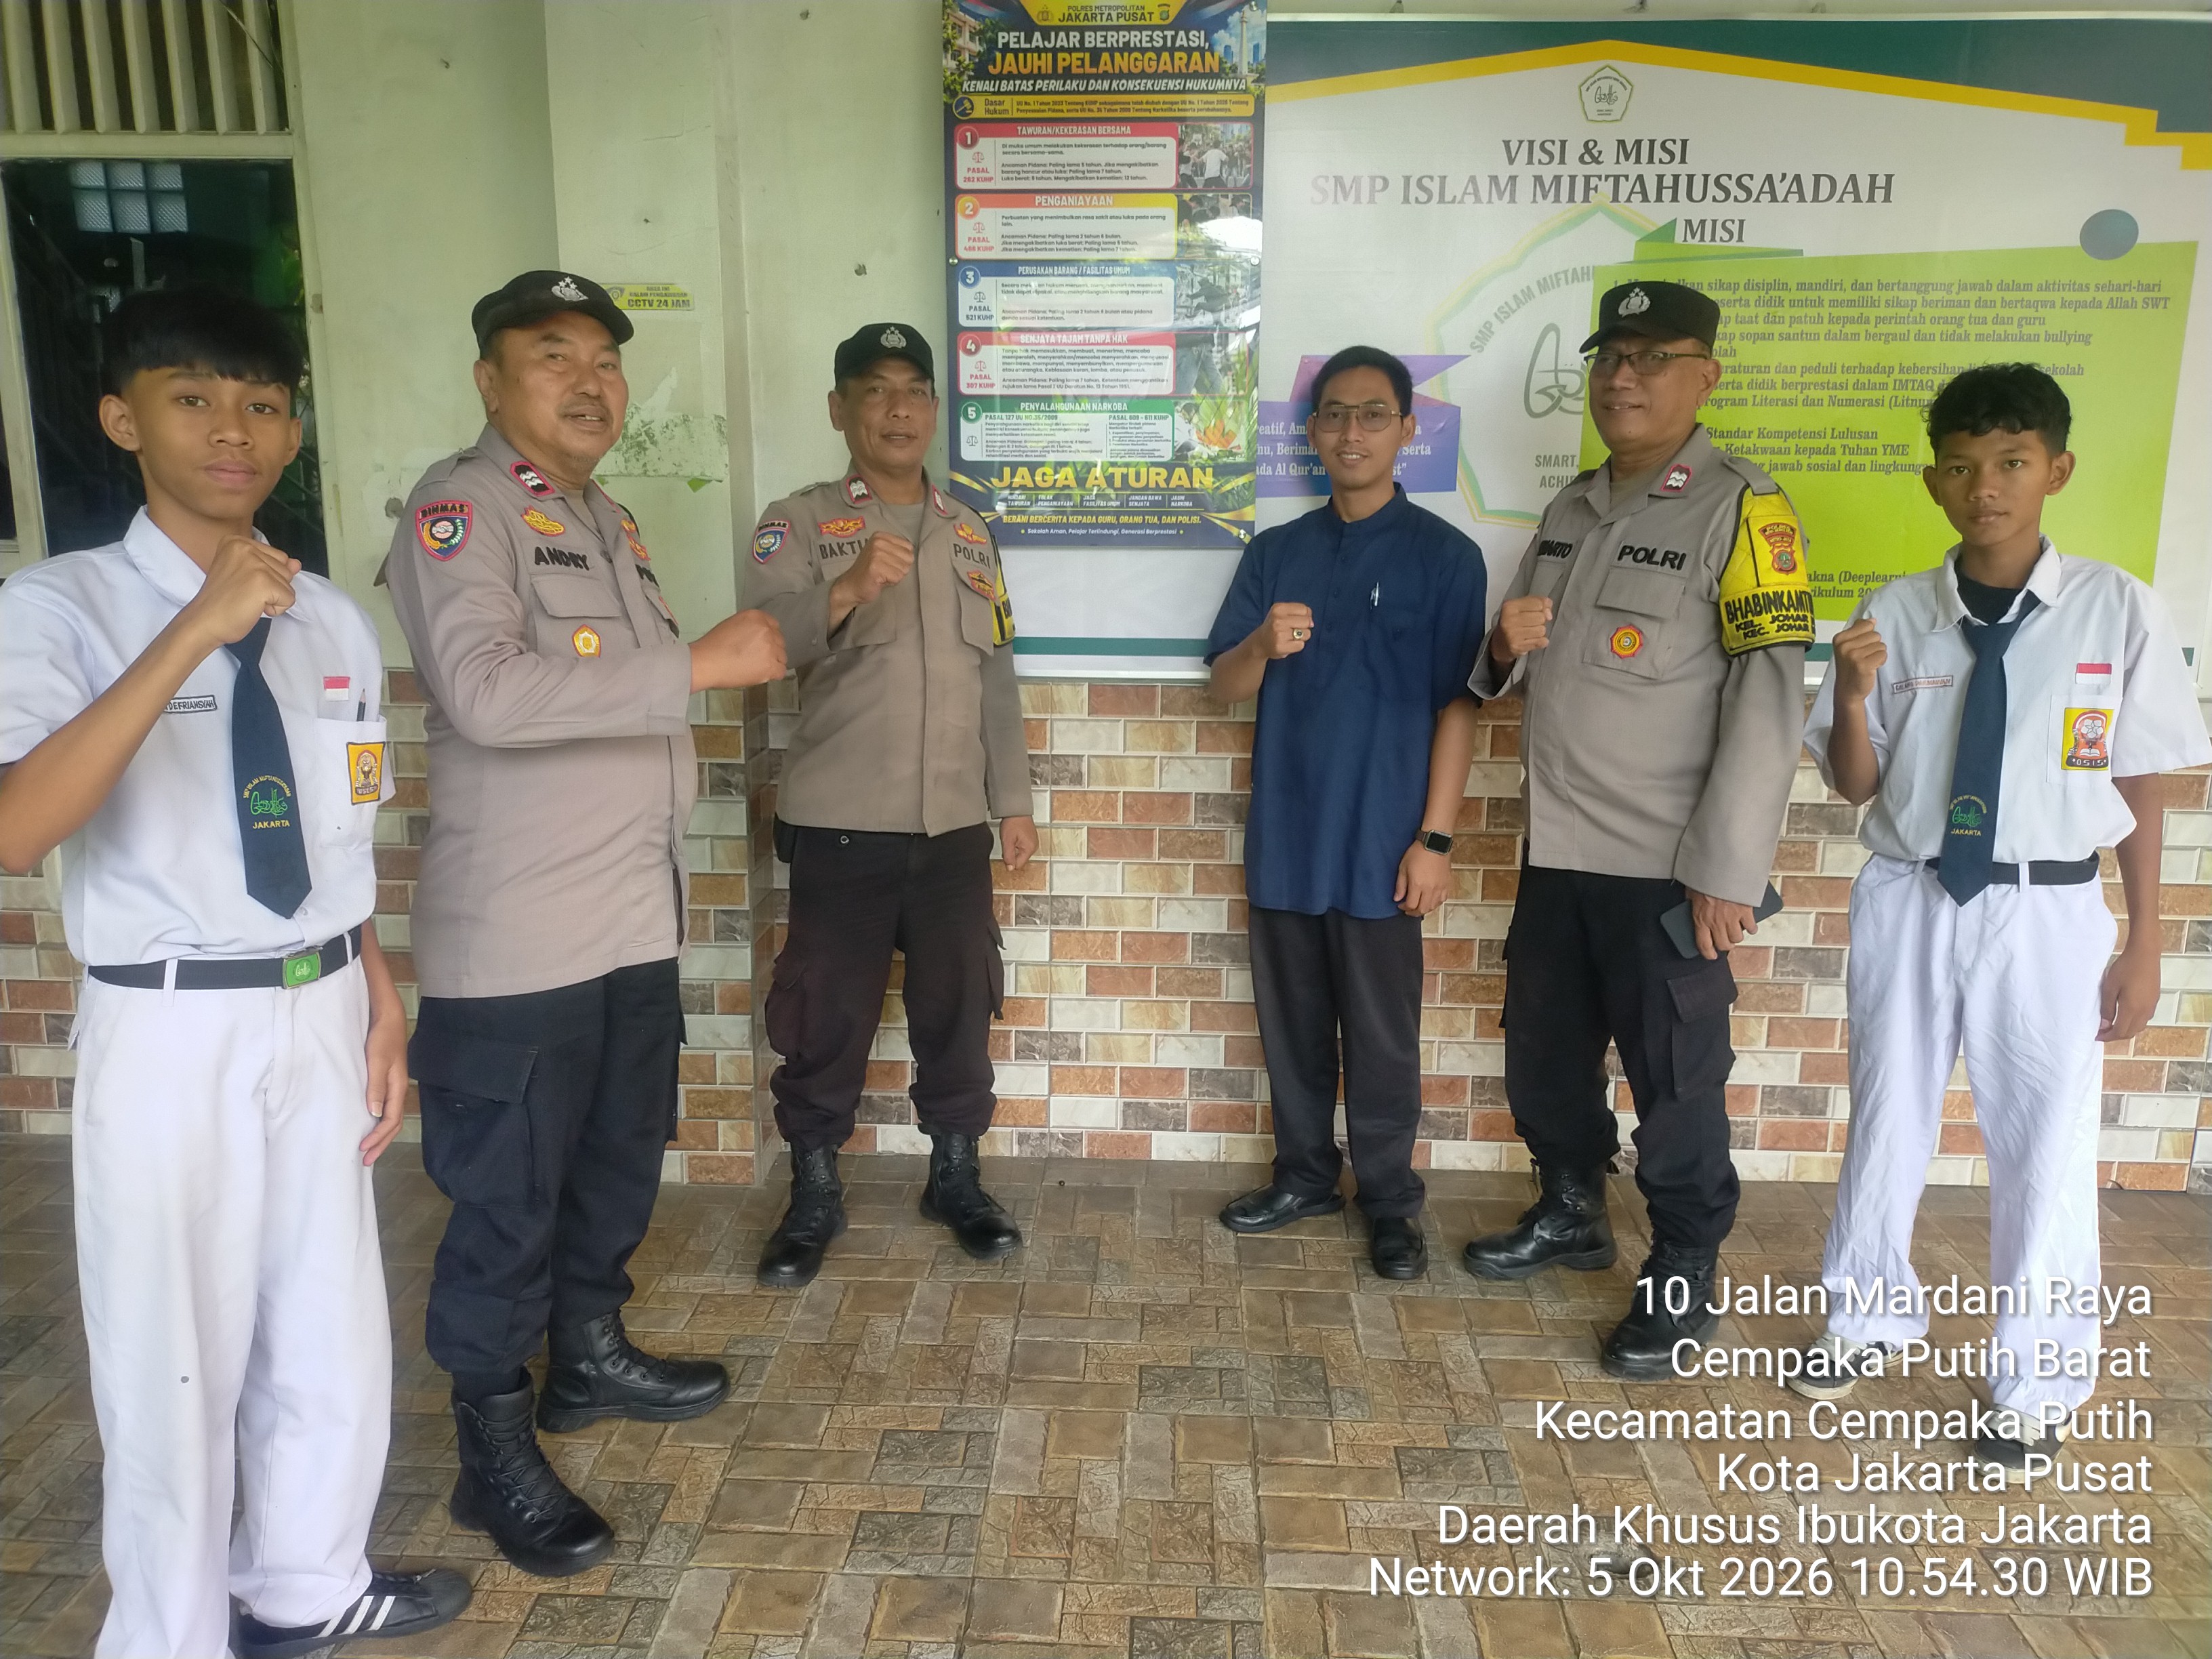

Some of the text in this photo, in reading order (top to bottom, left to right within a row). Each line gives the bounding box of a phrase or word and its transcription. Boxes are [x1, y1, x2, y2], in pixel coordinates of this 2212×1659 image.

[1059, 12, 1154, 22] JAKARTA PUSAT
[998, 30, 1209, 50] PELAJAR BERPRESTASI,
[988, 52, 1220, 75] JAUHI PELANGGARAN
[963, 79, 1246, 92] KENALI BATAS PERILAKU DAN KONSEKUENSI HUKUMNYA
[1017, 126, 1131, 135] TAWURAN/KEKERASAN BERSAMA
[966, 132, 971, 144] 1
[1501, 138, 1689, 167] VISI & MISI
[1309, 171, 1895, 205] SMP ISLAM MIFTAHUSSA'ADAH
[1036, 196, 1113, 206] PENGANIAYAAN
[965, 203, 973, 214] 2
[1683, 219, 1746, 244] MISI
[1019, 266, 1052, 274] PERUSAKAN
[1054, 266, 1078, 274] BARANG
[1083, 266, 1113, 274] FASILITAS
[966, 271, 975, 283] 3
[1708, 279, 1740, 295] sikap
[1744, 279, 1792, 294] disiplin,
[1796, 279, 1846, 293] mandiri,
[1851, 279, 1872, 291] dan
[1877, 279, 1954, 295] bertanggung
[1957, 279, 1992, 294] jawab
[1996, 280, 2032, 291] dalam
[2036, 280, 2090, 292] aktivitas
[2094, 280, 2161, 292] sehari-hari
[628, 300, 654, 308] CCTV
[1469, 266, 1595, 354] SMP ISLAM MIFTAH
[1755, 296, 2170, 312] didik untuk memiliki sikap beriman dan bertaqwa kepada Allah SWT
[1021, 335, 1128, 344] SENJATA TAJAM TANPA HAK
[1739, 330, 2092, 345] sopan santun dalam bergaul dan tidak melakukan bullying
[966, 340, 975, 352] 4
[968, 407, 976, 419] 5
[1021, 403, 1128, 411] PENYALAHGUNAAN NARKOBA
[1706, 427, 1877, 442] Standar Kompetensi Lulusan
[1402, 444, 1431, 455] Serta
[1725, 443, 1909, 458] Ketakwaan kepada Tuhan YME
[1275, 462, 1326, 476] Al Qur'an
[991, 466, 1213, 488] JAGA ATURAN
[421, 504, 465, 517] BINMAS
[1003, 515, 1201, 525] BERANI BERCERITA KEPADA GURU, ORANG TUA, DAN POLISI.
[535, 546, 590, 571] ANDRY
[953, 544, 991, 569] POLRI
[1618, 545, 1687, 571] POLRI
[1769, 613, 1809, 623] JOHAR
[1775, 623, 1809, 633] JOHAR
[166, 700, 214, 710] DEFRIANSYAH
[253, 820, 290, 829] JAKARTA
[1951, 828, 1981, 836] JAKARTA
